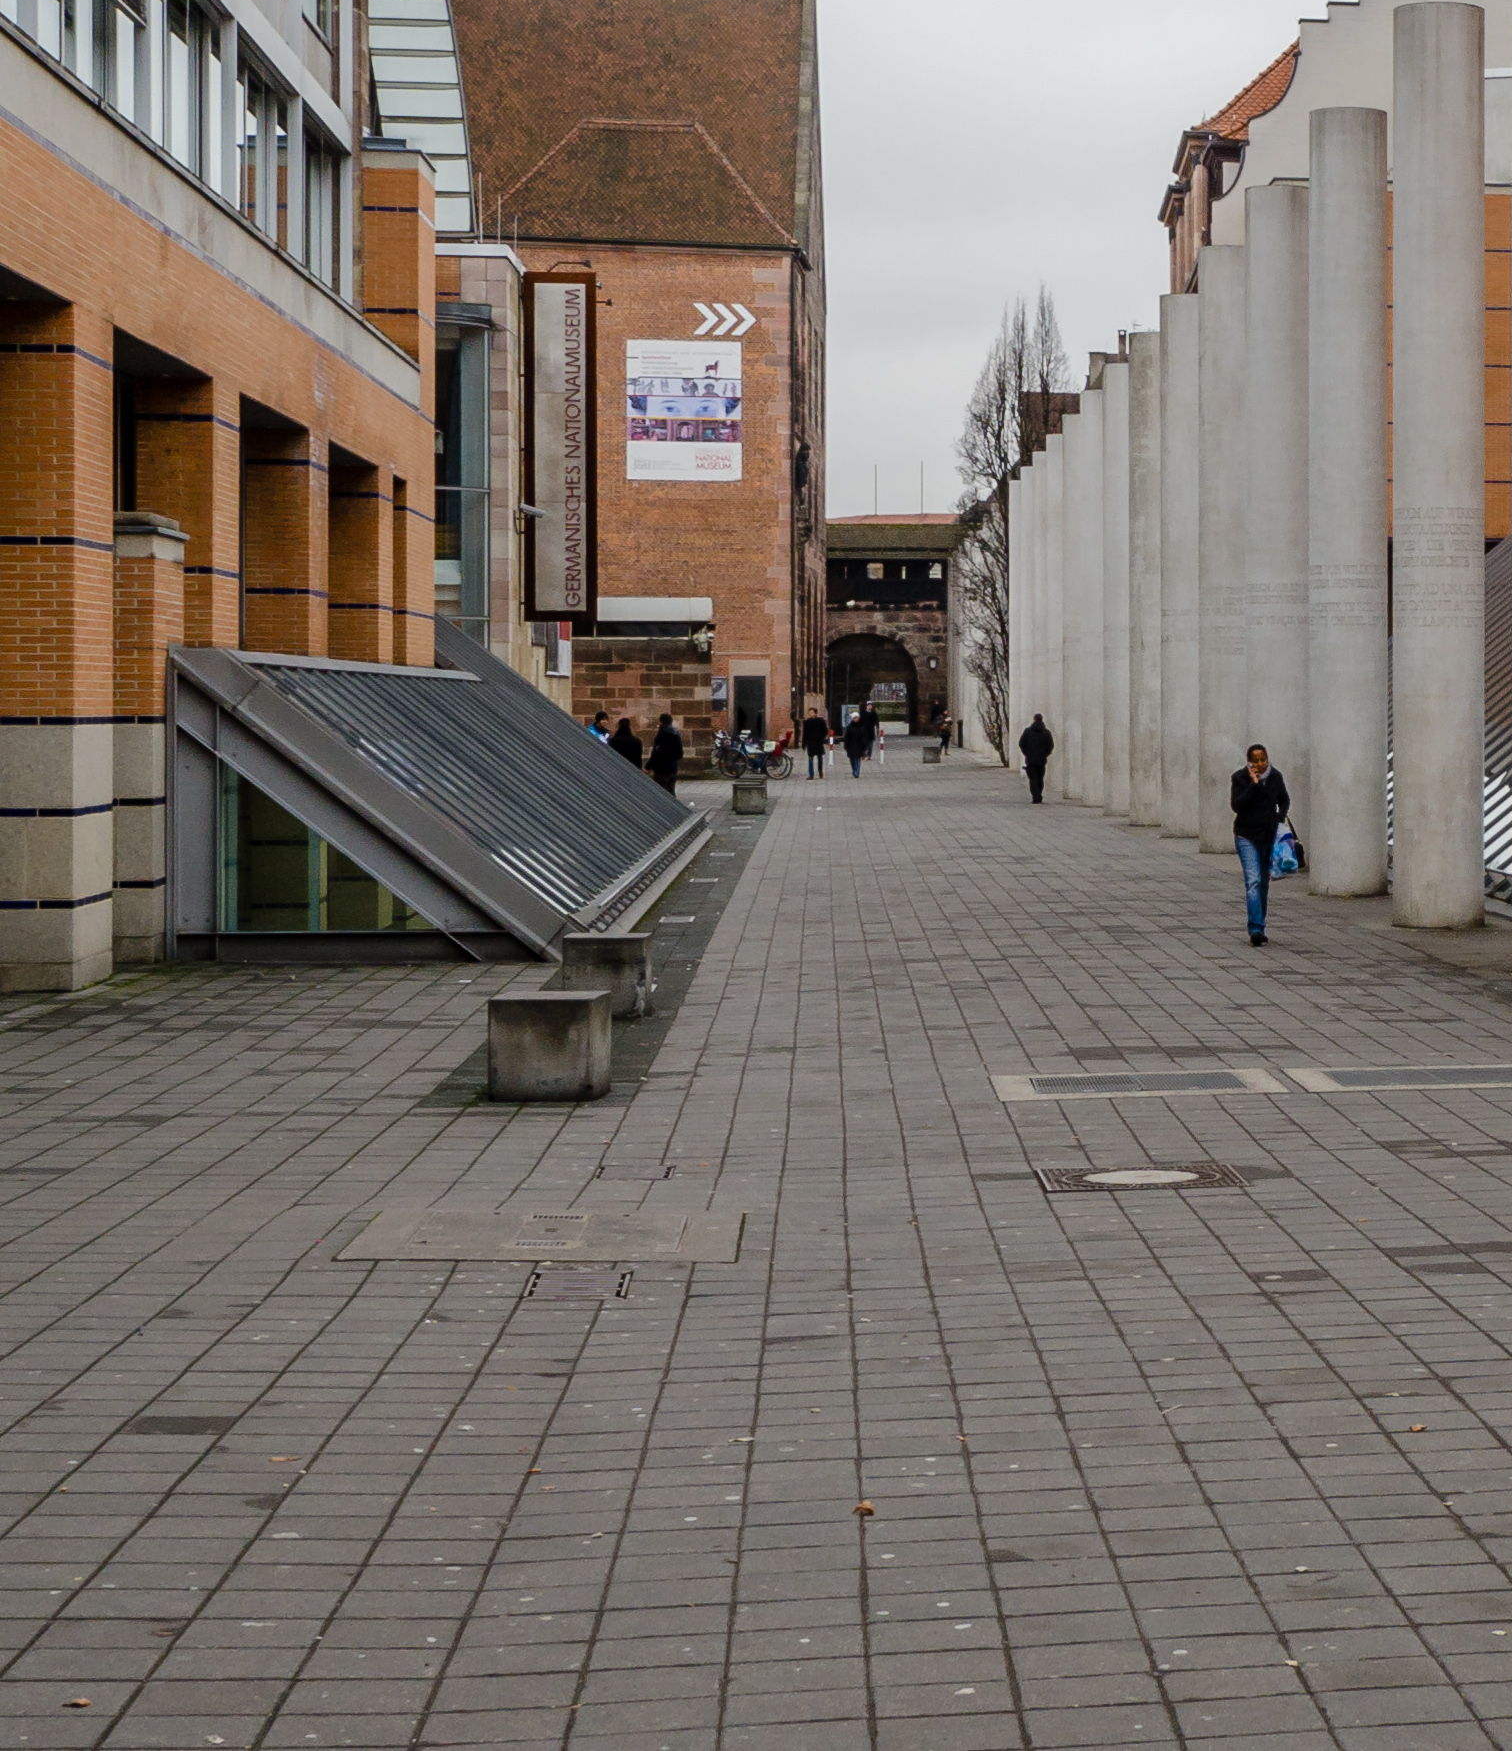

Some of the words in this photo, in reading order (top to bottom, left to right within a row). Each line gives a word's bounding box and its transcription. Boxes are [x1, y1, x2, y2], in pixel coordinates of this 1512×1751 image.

[564, 288, 581, 458] NATIONALMUSEUM
[564, 465, 582, 608] GERMANISCHES
[695, 462, 733, 470] MUSEUM
